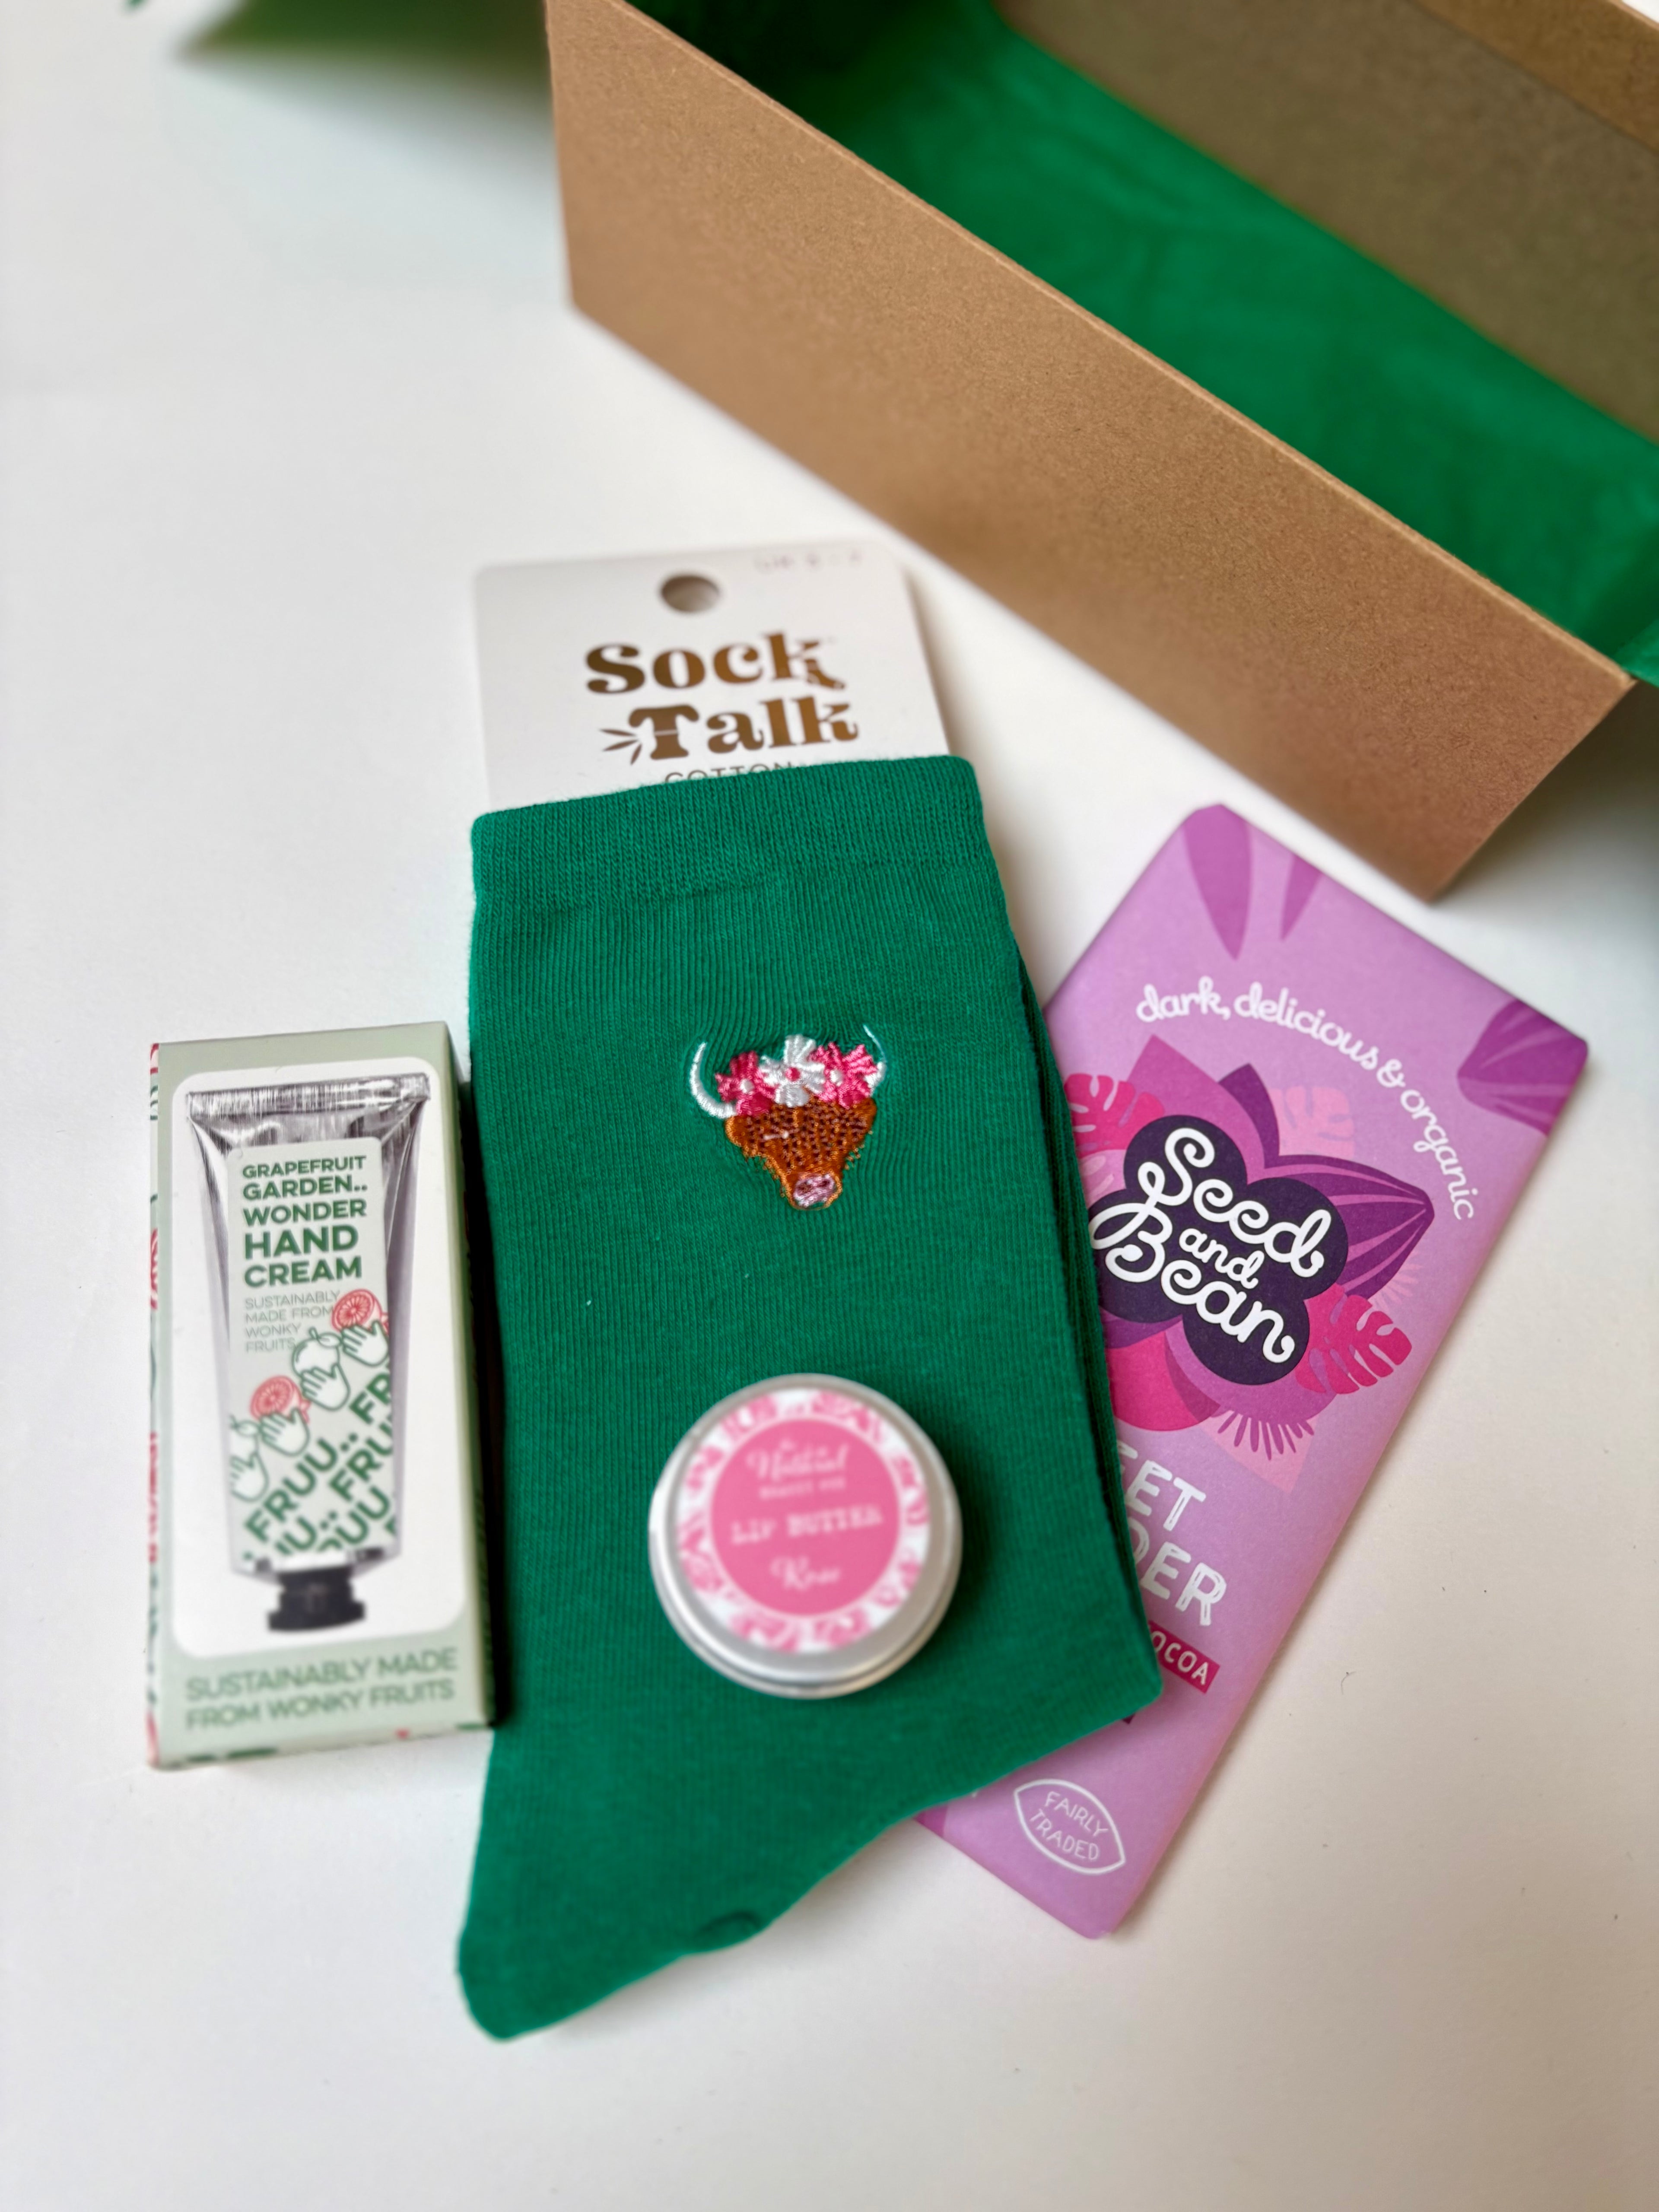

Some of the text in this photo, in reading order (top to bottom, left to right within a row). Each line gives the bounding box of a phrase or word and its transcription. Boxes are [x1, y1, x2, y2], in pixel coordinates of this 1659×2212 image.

[585, 629, 846, 694] Sock
[628, 694, 858, 760] Talk
[1136, 975, 1479, 1220] dark, delicious & organic
[242, 1155, 367, 1179] GRAPEFRUIT
[243, 1198, 367, 1227] WONDER
[1138, 1127, 1332, 1278] Seed
[245, 1224, 359, 1260] HAND
[1179, 1228, 1265, 1289] and
[244, 1256, 362, 1288] CREAM
[1088, 1202, 1295, 1363] Bean
[245, 1290, 340, 1309] SUSTAINABLY
[246, 1305, 333, 1323] MADE FROM
[246, 1323, 301, 1338] WONKY
[246, 1337, 296, 1353] FRUITS
[186, 1647, 458, 1702] SUSTAINABLY MADE
[186, 1678, 454, 1731] FROM WONKY FRUITS
[1029, 1808, 1100, 1862] TRADED
[1044, 1790, 1109, 1838] FAIRLY
